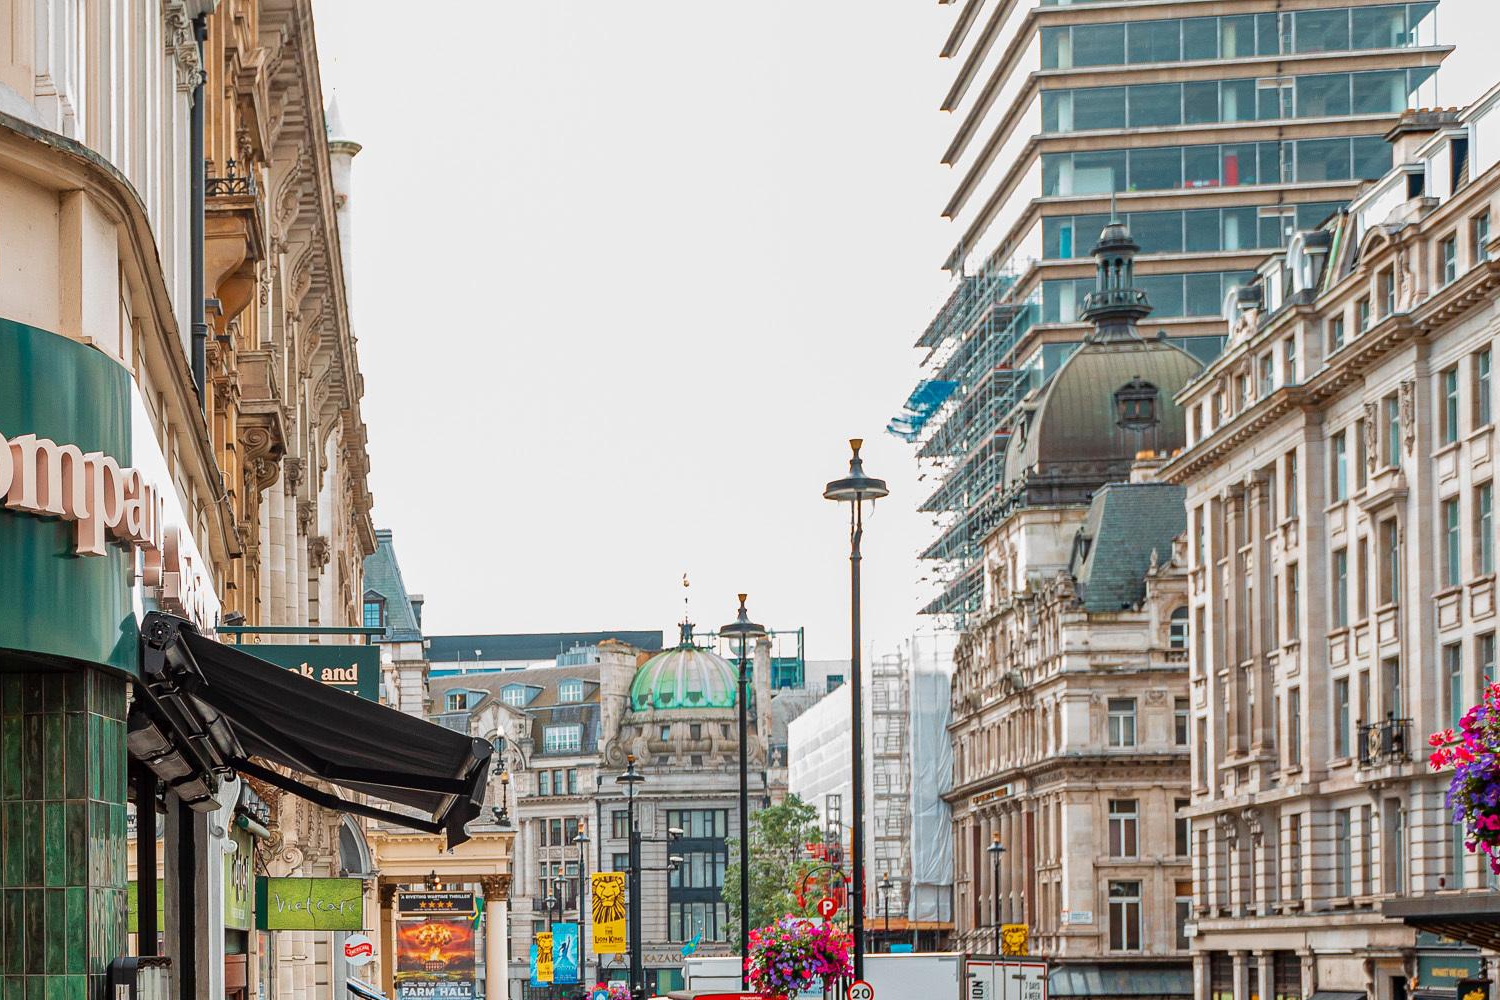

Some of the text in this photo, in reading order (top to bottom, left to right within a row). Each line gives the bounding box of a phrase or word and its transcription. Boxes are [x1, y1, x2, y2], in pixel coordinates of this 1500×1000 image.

[321, 663, 358, 681] and
[823, 901, 833, 915] P
[402, 987, 472, 997] FARM HALL
[852, 988, 870, 999] 20
